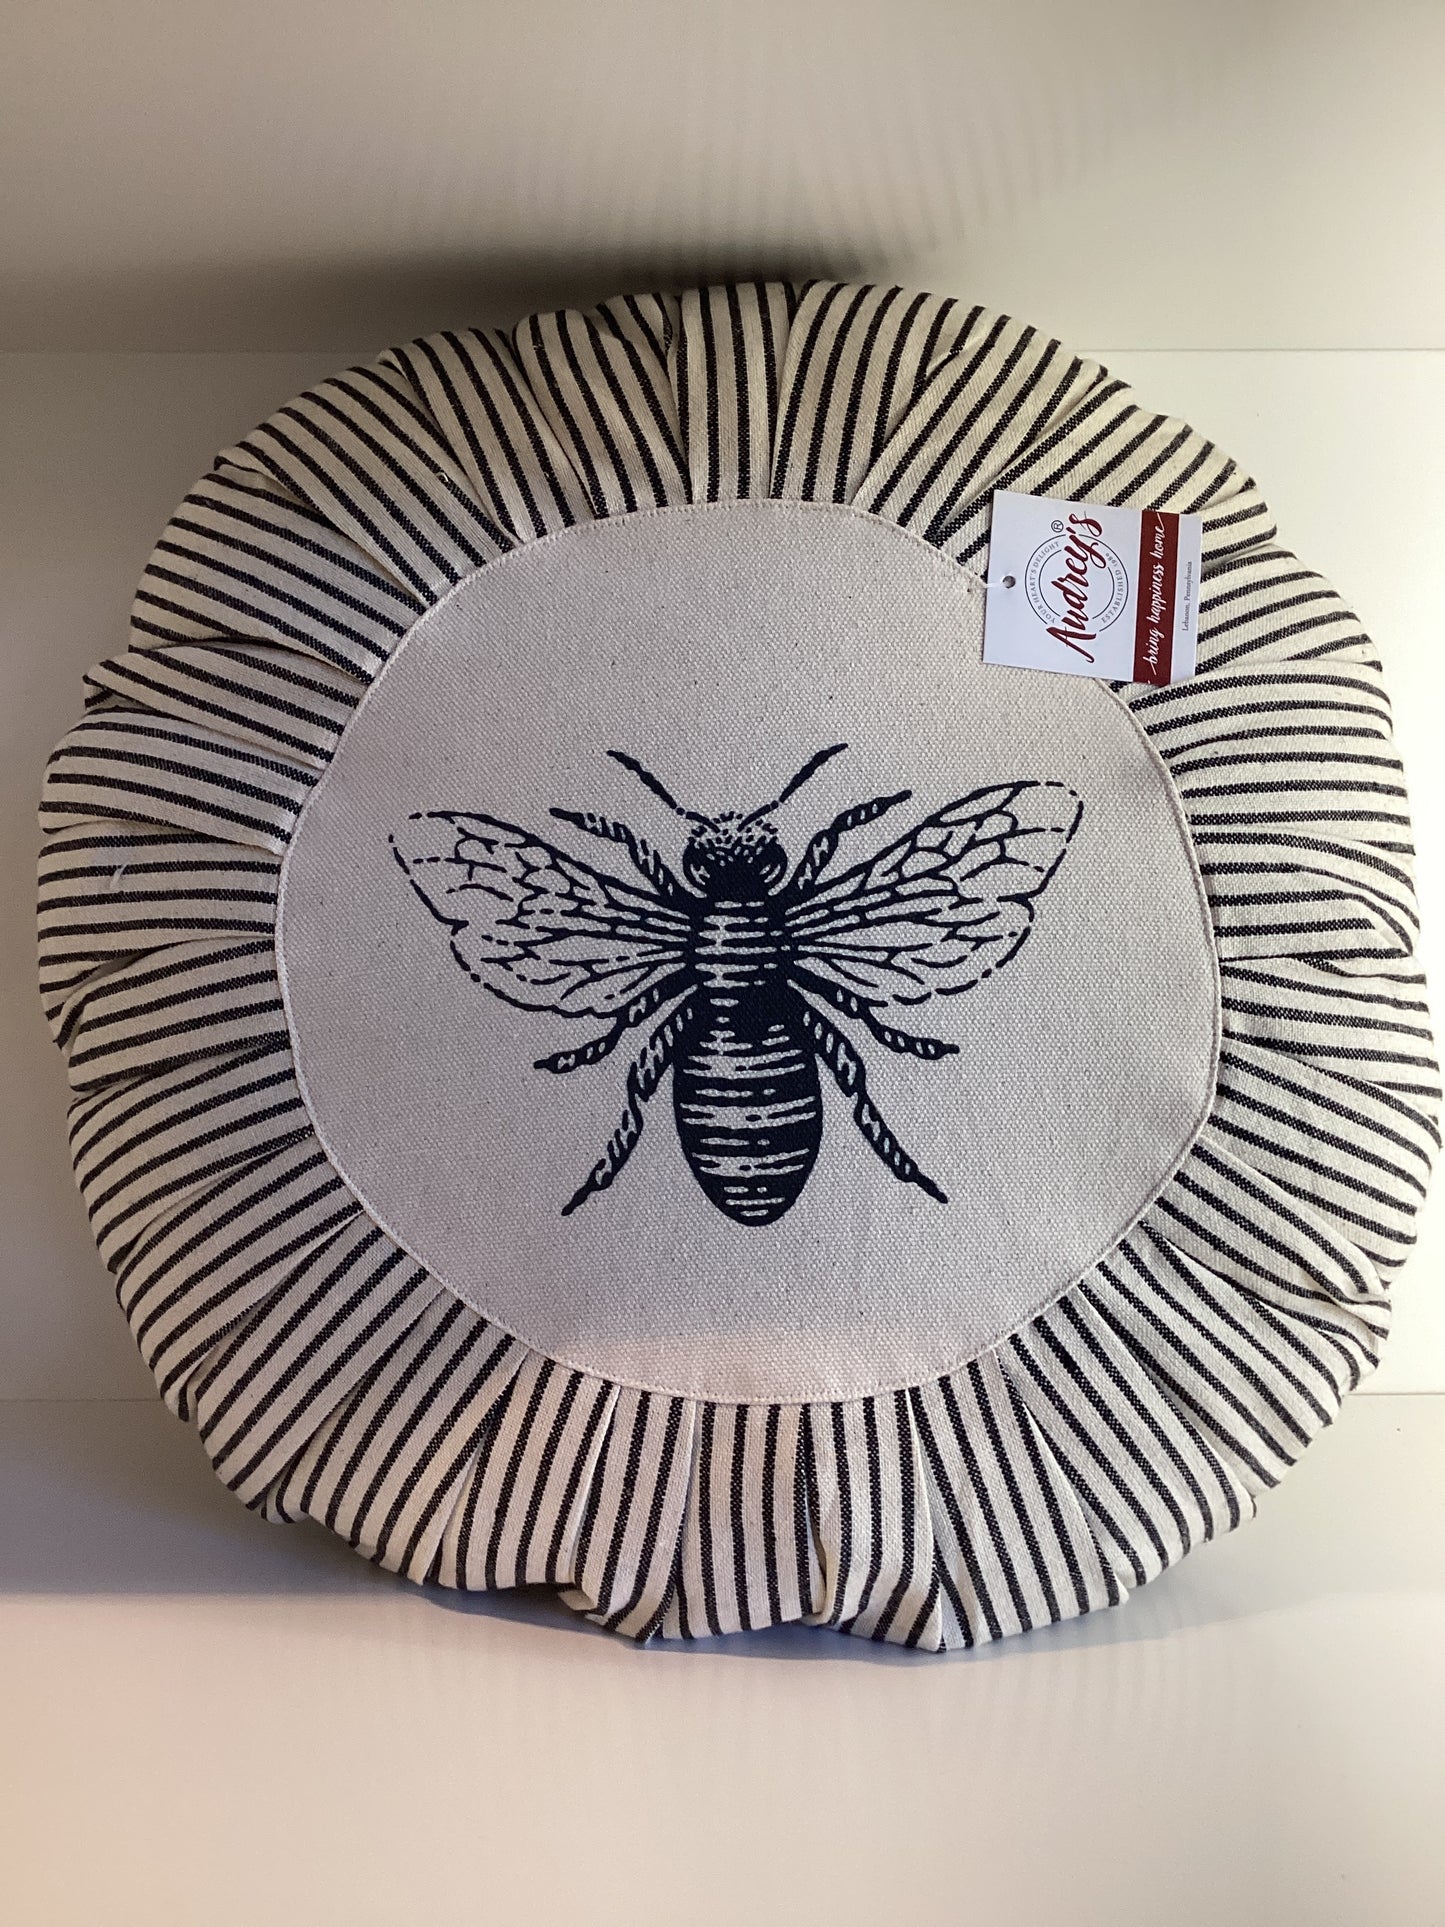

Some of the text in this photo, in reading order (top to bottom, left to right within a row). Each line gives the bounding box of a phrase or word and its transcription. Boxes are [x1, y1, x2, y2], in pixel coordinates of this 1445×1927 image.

[1029, 541, 1060, 624] YOUR HEART'S DELIGHT
[1046, 511, 1107, 663] Audrey's
[1101, 569, 1124, 623] ESTABLISHED
[1142, 512, 1167, 675] bring happiness home
[1183, 561, 1194, 601] Pennsylvania
